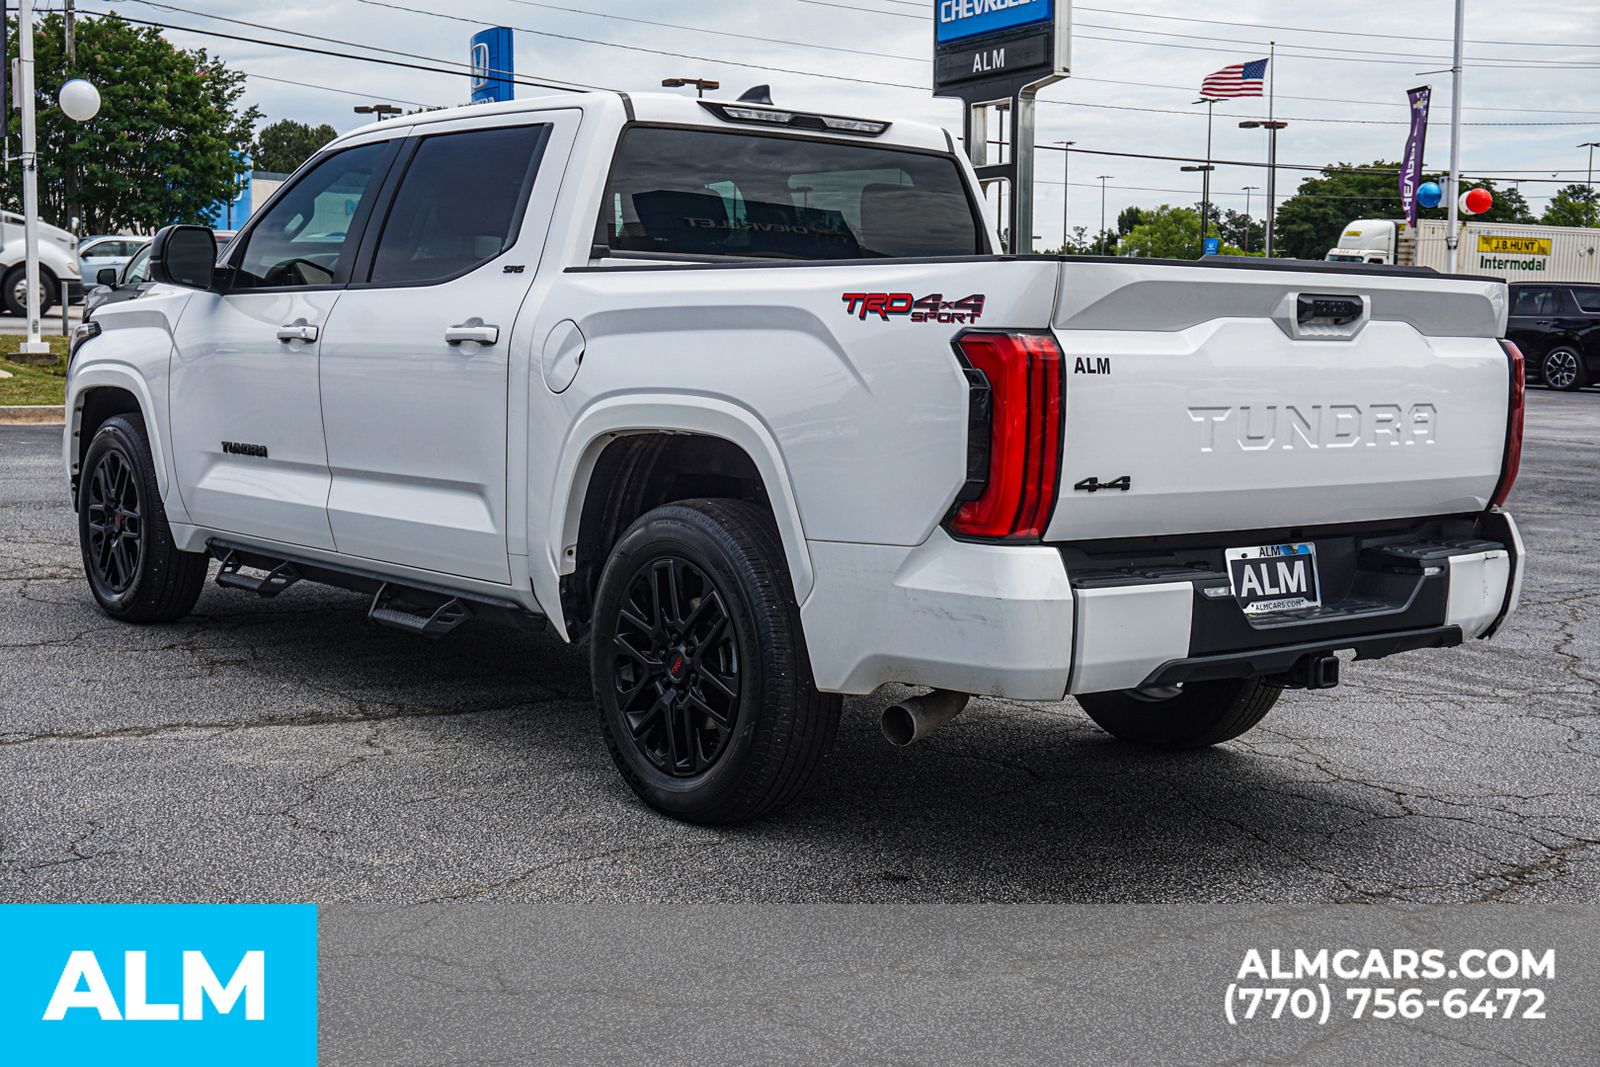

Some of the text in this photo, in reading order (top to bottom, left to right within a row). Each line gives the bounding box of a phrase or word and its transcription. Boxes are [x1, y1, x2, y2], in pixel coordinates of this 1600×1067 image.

[940, 0, 1038, 23] CHEVR
[972, 48, 1005, 73] ALM
[1510, 241, 1536, 251] HUNT
[1480, 255, 1546, 271] Intermodal
[842, 293, 986, 322] TRD 4x4
[910, 312, 981, 324] SPORT
[1074, 357, 1111, 374] ALM
[1187, 403, 1438, 452] TUNDRA
[221, 441, 268, 458] TUNDRA
[1074, 476, 1131, 492] 4x4
[1259, 545, 1281, 557] ALM
[1241, 560, 1307, 597] ALM
[1255, 600, 1302, 611] ALMCARS.COM
